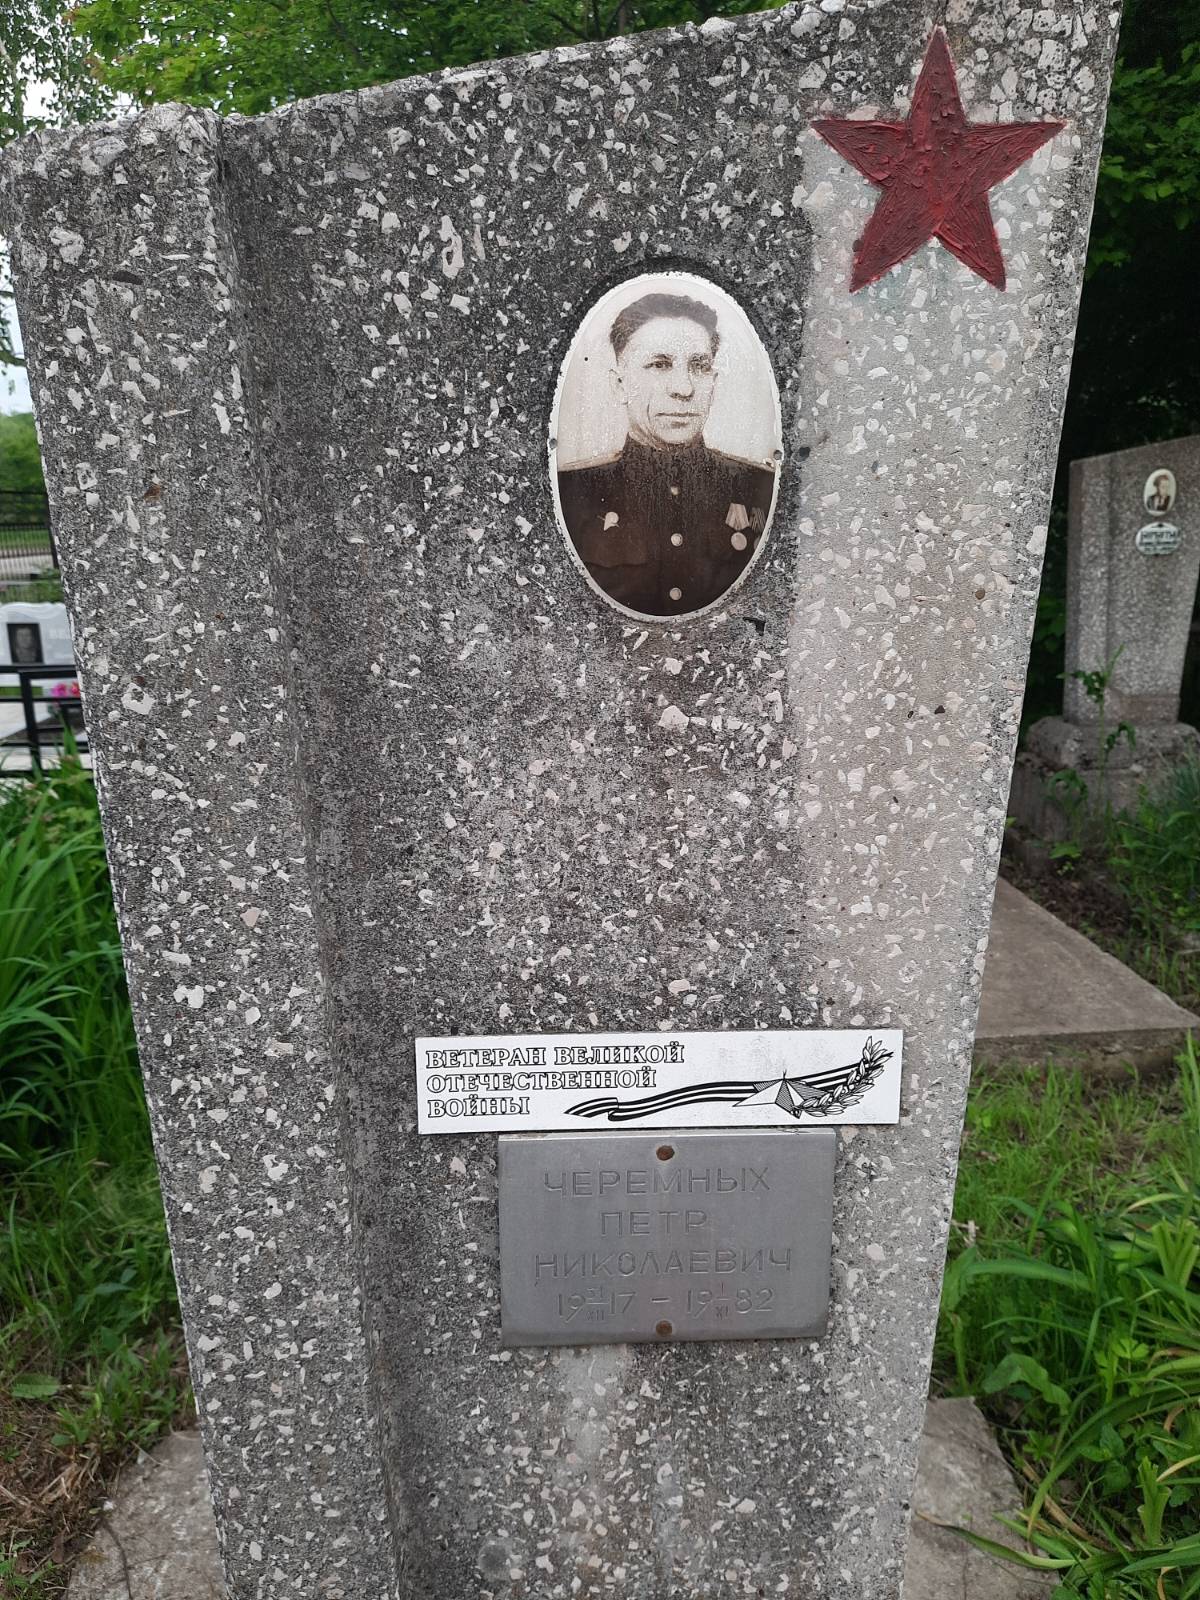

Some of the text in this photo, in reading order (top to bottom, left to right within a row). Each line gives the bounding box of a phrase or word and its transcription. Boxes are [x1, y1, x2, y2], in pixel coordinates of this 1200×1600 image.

[426, 1041, 685, 1069] ВЕТЕРАН ВЕЛИКОЙ
[426, 1066, 657, 1093] ОТЕЧЕСТВЕННОЙ
[427, 1094, 530, 1118] ВОЙНЫ
[544, 1166, 770, 1197] ЧЕРЕМНЫХ
[601, 1210, 708, 1237] ПЕТР
[535, 1248, 793, 1280] НИКОЛАЕВИЧ
